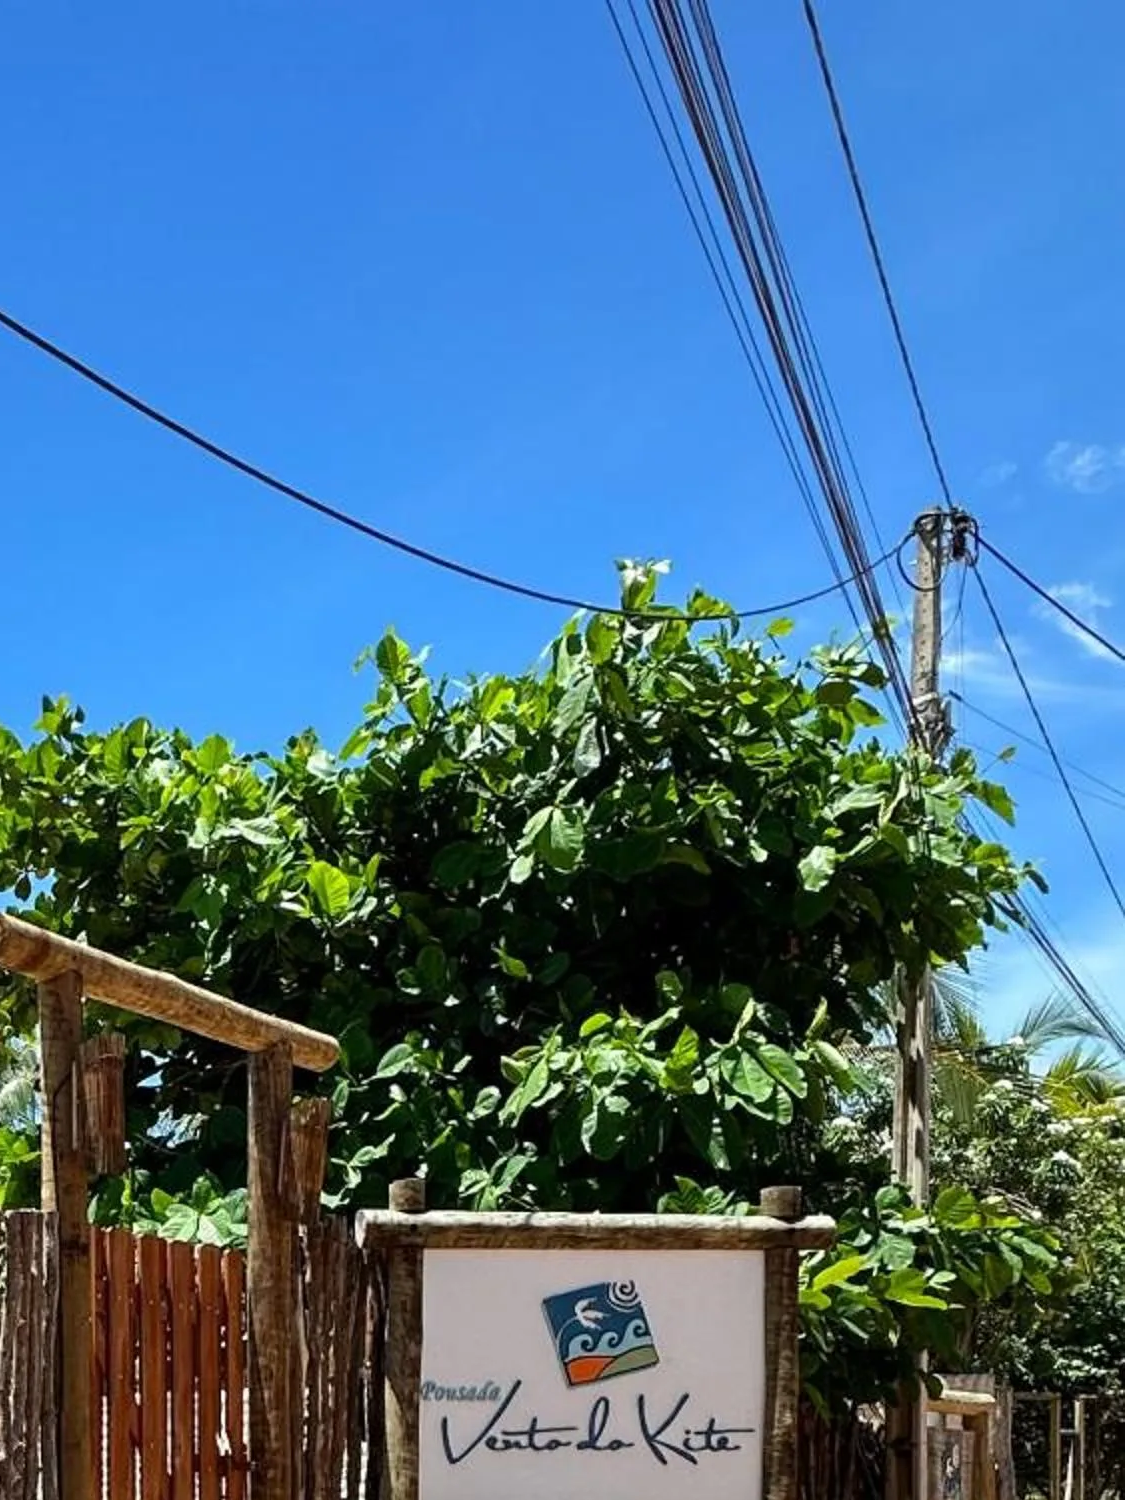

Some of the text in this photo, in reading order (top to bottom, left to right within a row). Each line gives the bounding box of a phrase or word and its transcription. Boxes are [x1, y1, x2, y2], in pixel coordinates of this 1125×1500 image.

[422, 1379, 501, 1401] Pousada
[441, 1379, 755, 1465] Vento do Kite
